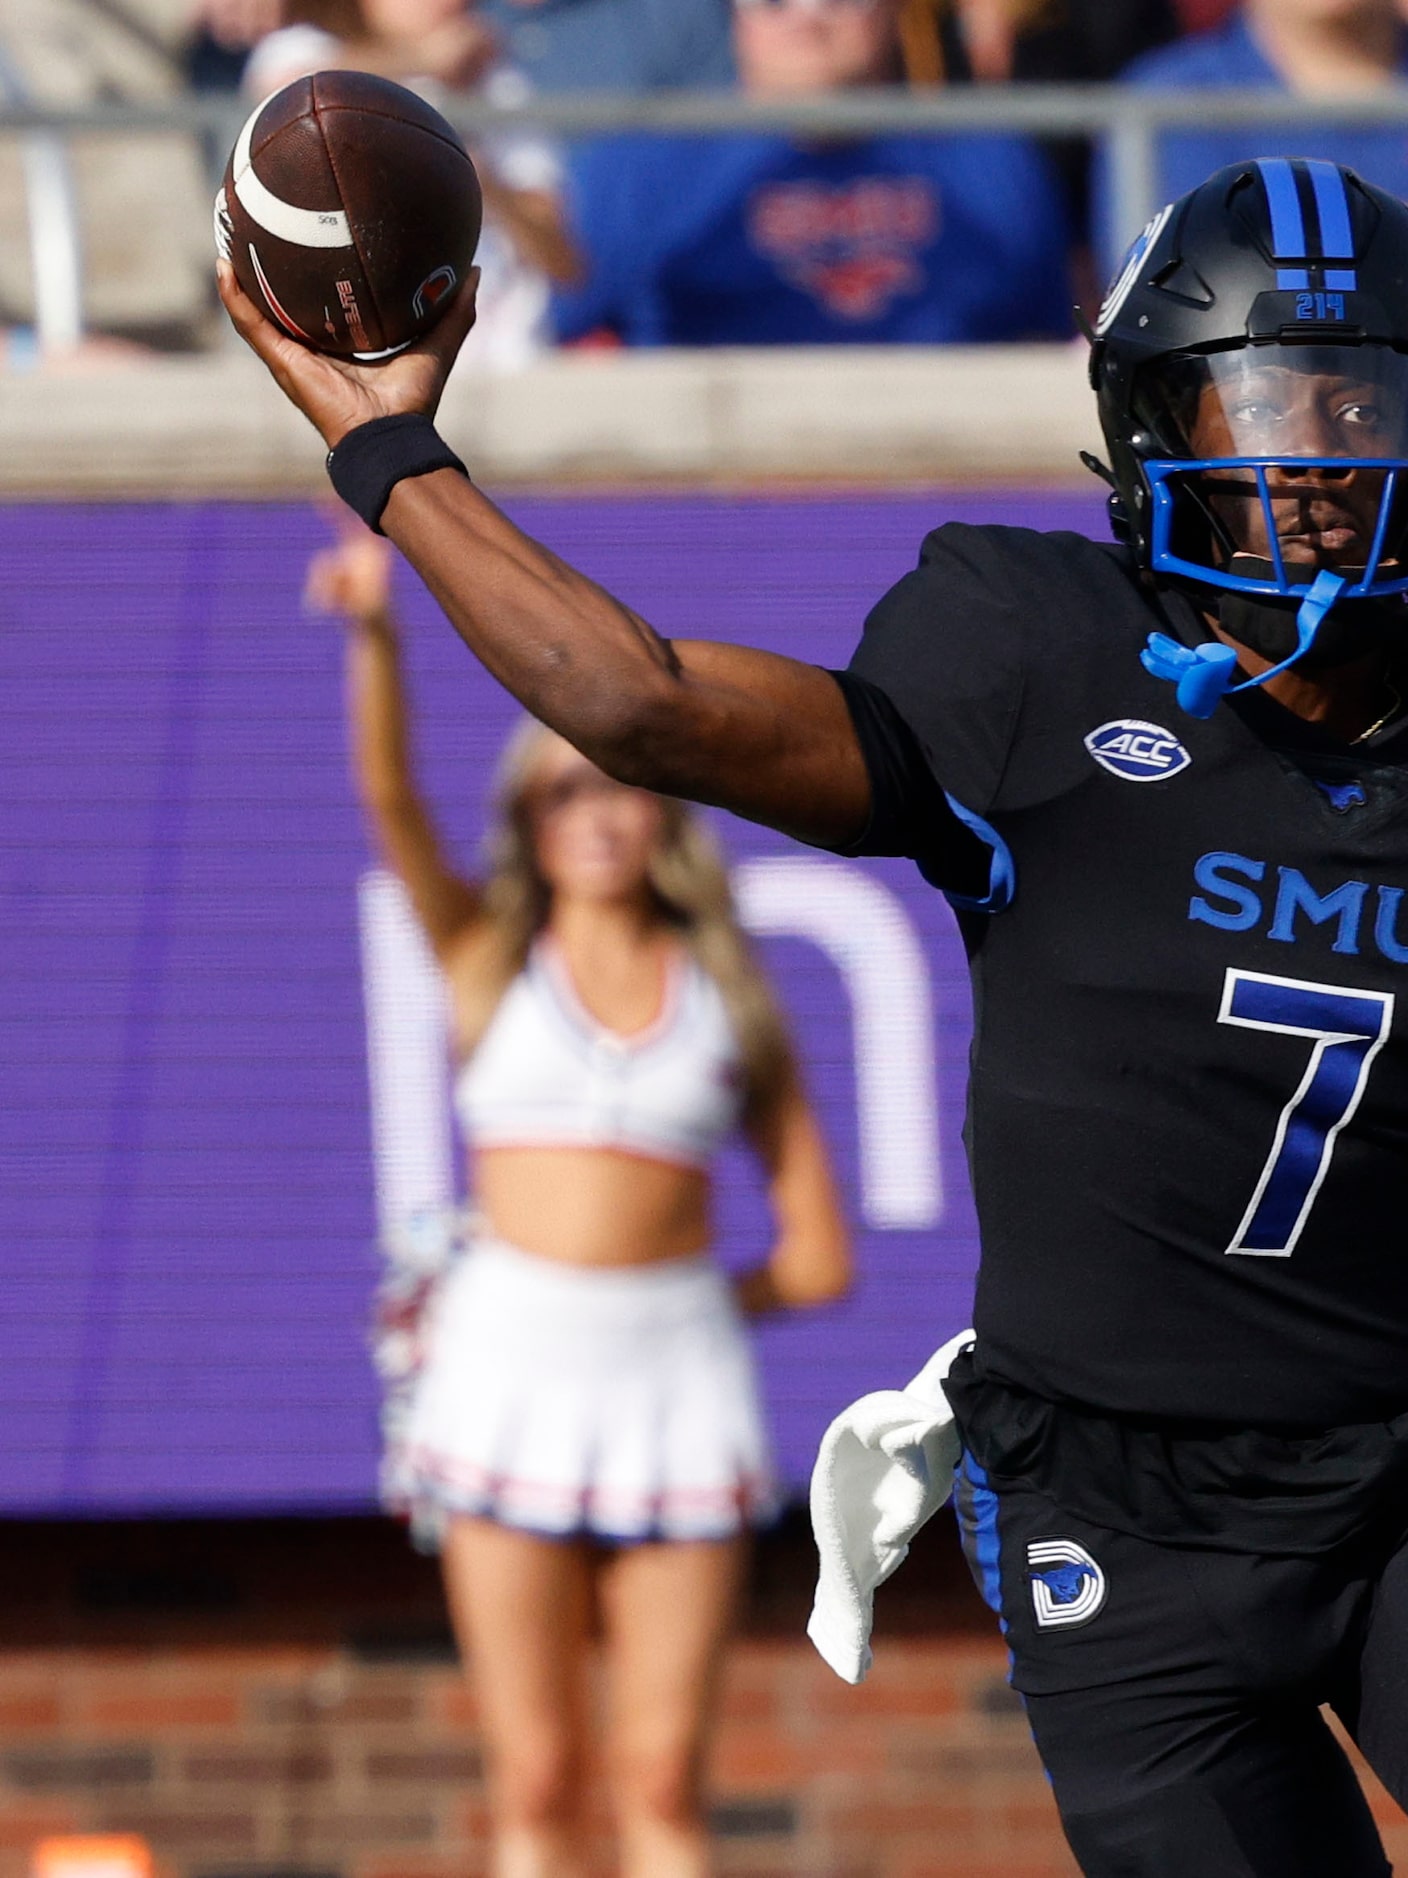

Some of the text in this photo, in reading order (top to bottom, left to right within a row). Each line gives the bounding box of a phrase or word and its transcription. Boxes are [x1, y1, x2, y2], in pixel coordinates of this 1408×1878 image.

[1296, 293, 1344, 320] 214
[1099, 733, 1179, 762] ACC
[1217, 967, 1395, 1257] 7
